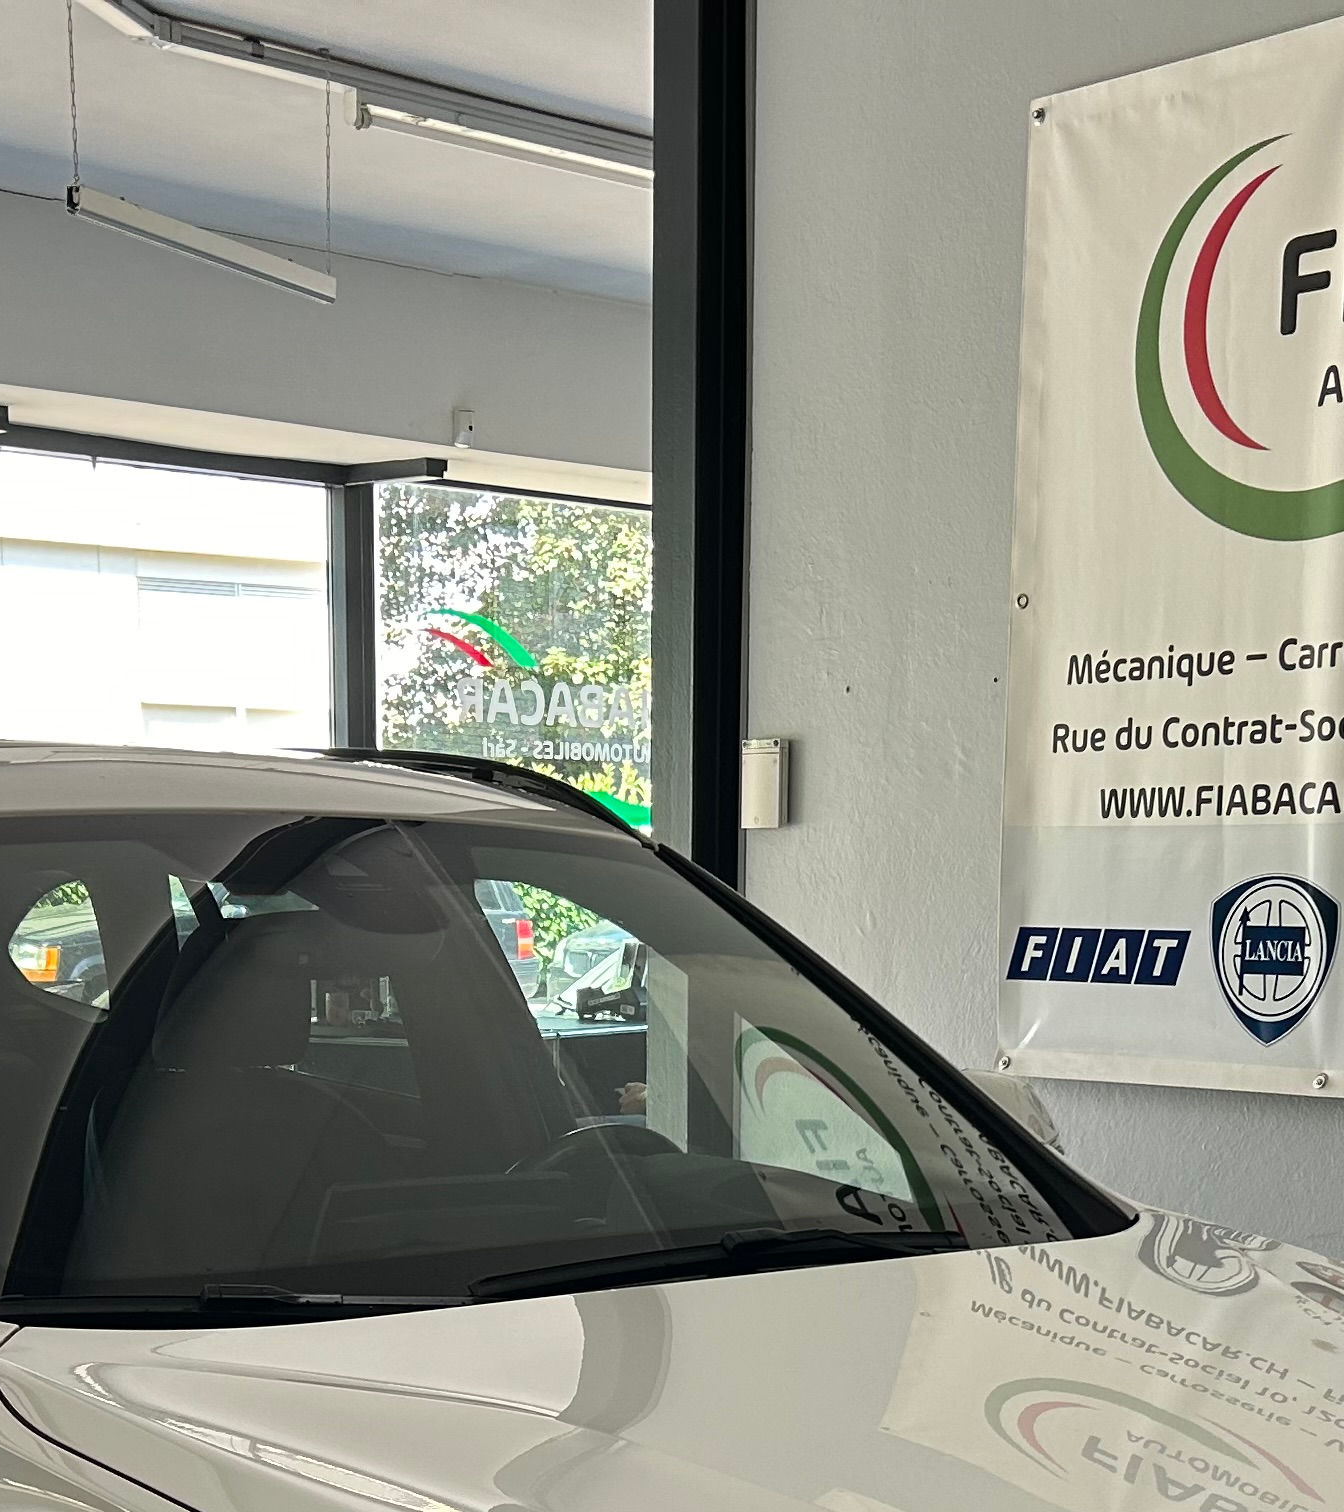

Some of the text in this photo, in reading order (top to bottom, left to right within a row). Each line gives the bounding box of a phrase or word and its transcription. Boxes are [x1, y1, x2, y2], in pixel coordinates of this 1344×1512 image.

[1065, 643, 1237, 688] Mécanique
[1051, 722, 1108, 755] Rue
[1114, 715, 1154, 752] du
[1020, 934, 1179, 976] FIAT
[1243, 938, 1303, 962] LANCIA
